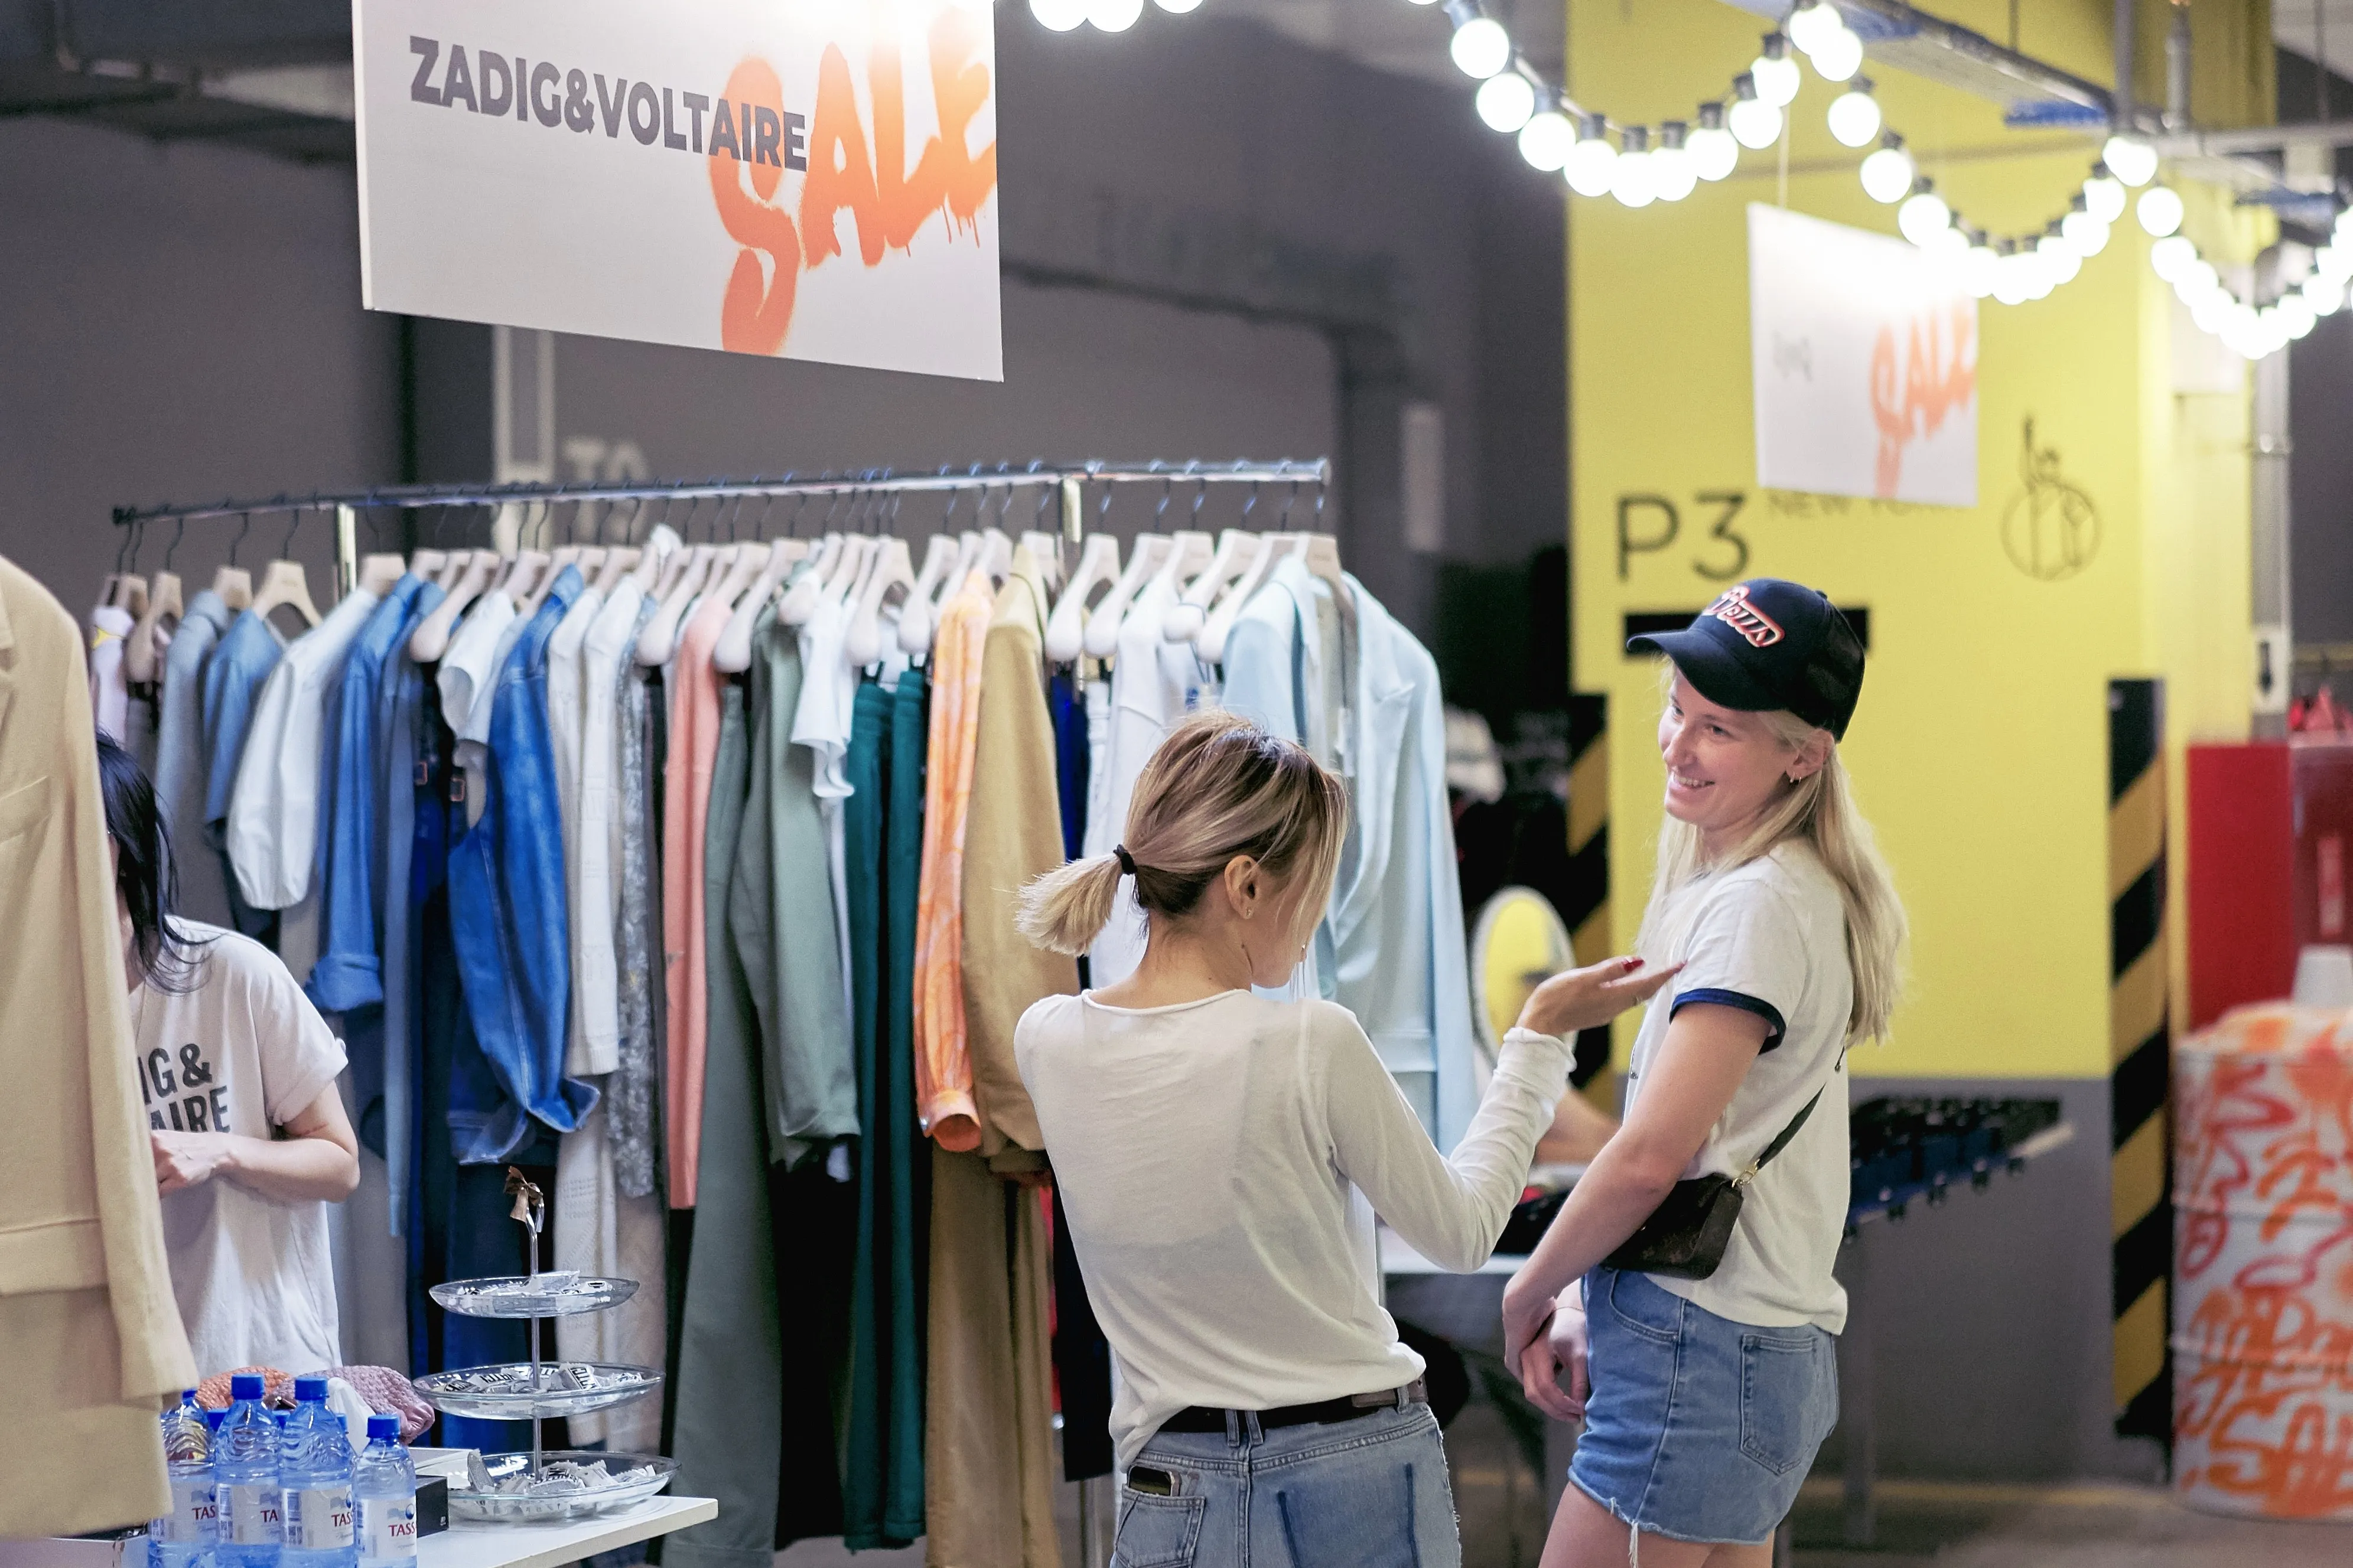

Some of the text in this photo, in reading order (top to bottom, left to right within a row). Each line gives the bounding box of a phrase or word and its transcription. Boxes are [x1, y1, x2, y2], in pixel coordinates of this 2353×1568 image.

[409, 35, 808, 173] ZADIG&VOLTAIRE
[1615, 491, 1750, 582] P3
[138, 1044, 212, 1105] IG&
[149, 1085, 231, 1133] AIRE
[192, 1505, 216, 1520] TAS
[261, 1509, 278, 1522] TA
[331, 1512, 353, 1527] TASS
[388, 1521, 415, 1537] TASS
